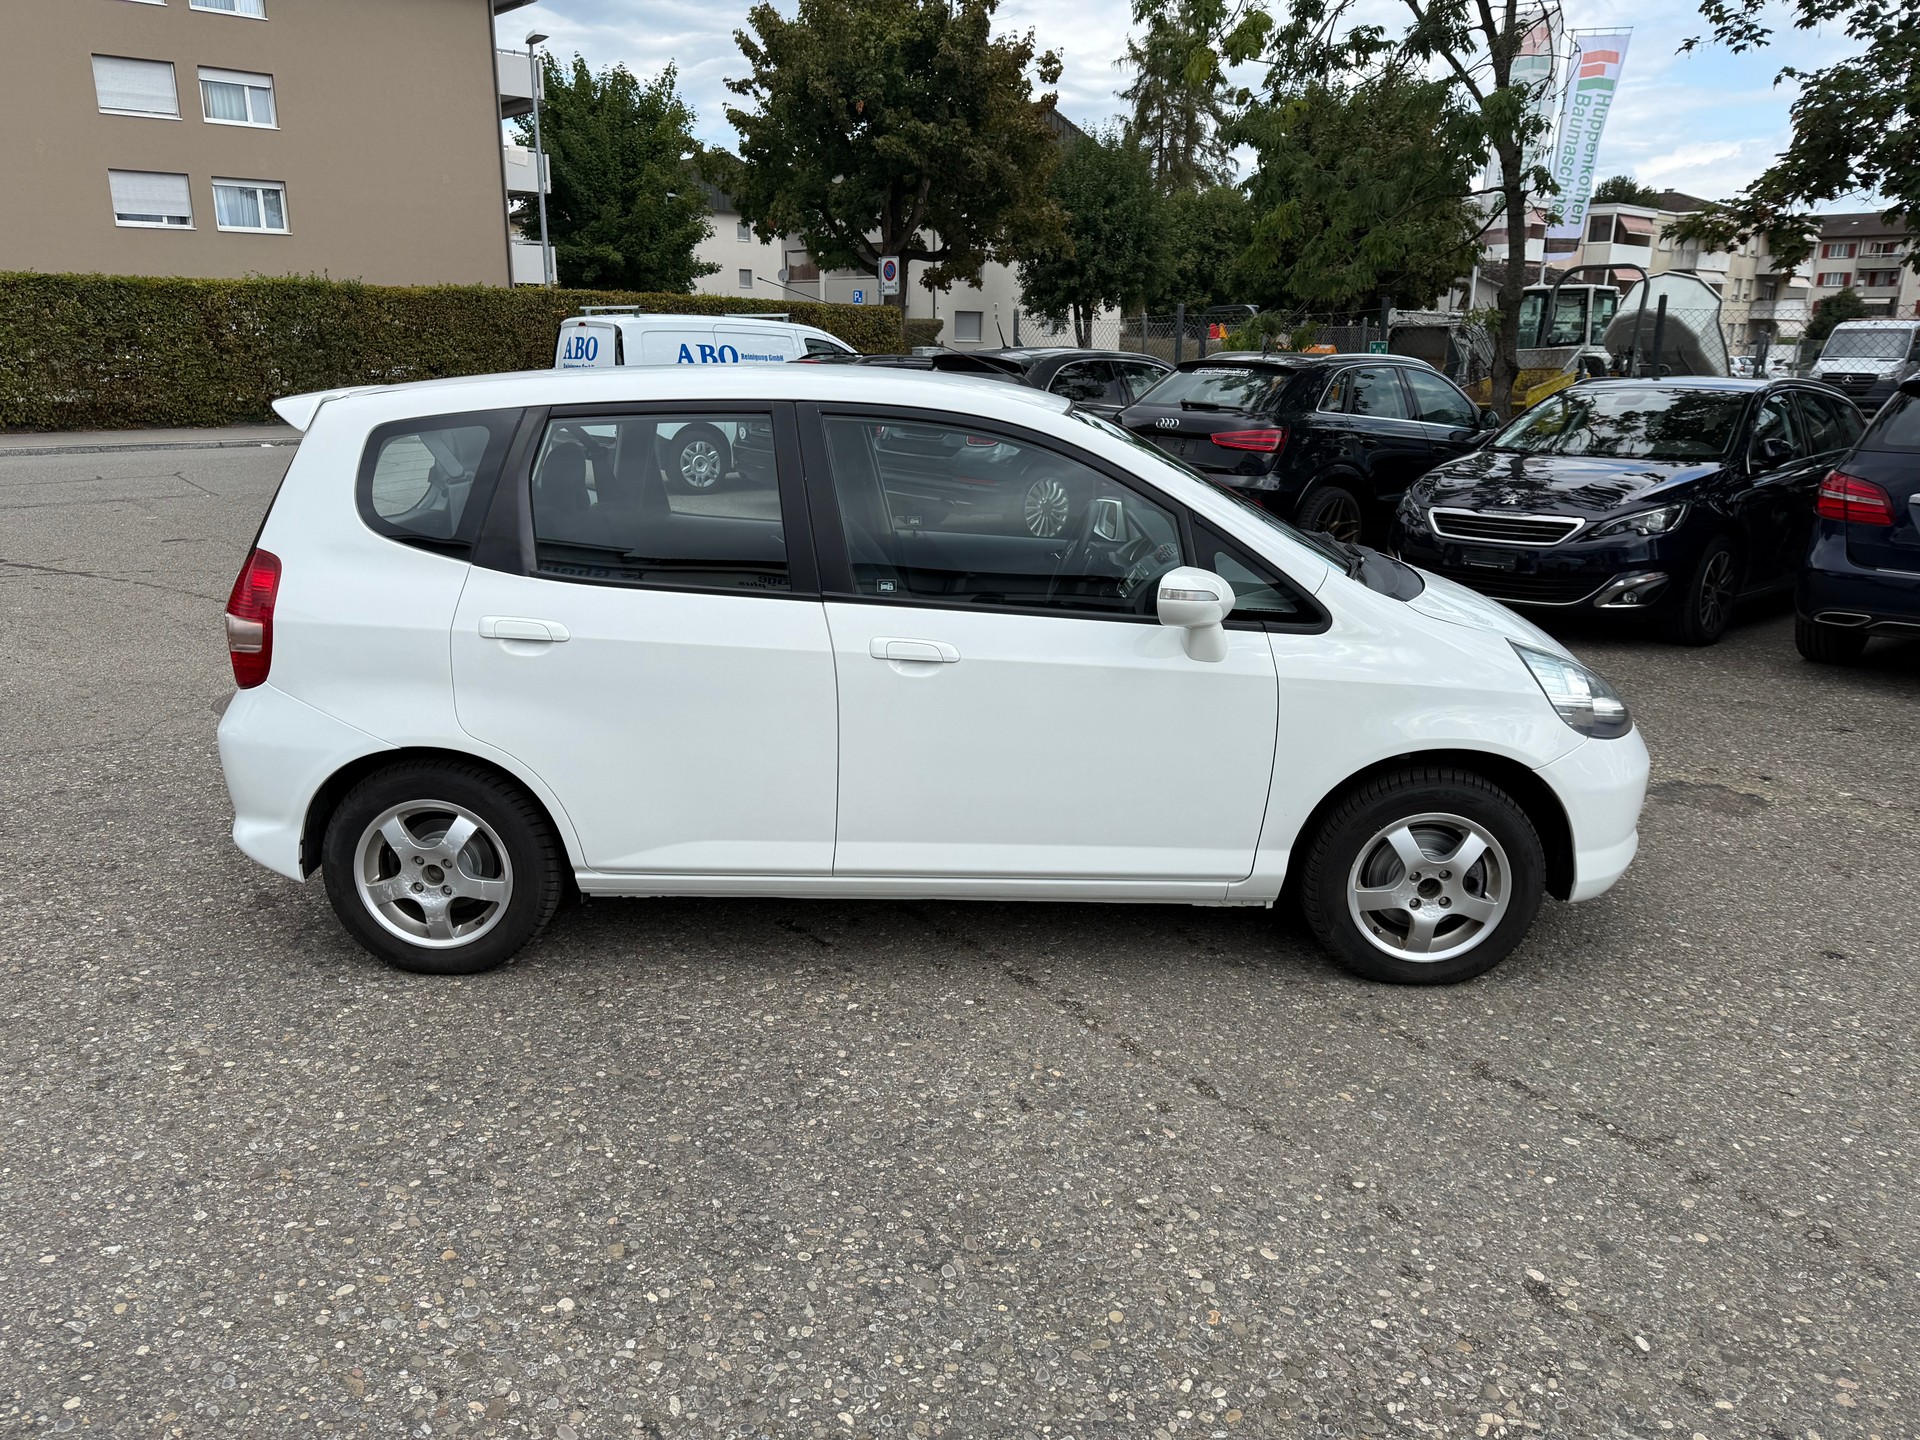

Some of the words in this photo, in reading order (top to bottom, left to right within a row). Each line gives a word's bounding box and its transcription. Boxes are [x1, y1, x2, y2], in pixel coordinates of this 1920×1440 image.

[1551, 93, 1592, 215] Baumaschine
[1569, 93, 1612, 225] Huppenkothen
[563, 336, 598, 361] ABO
[677, 343, 738, 364] ABO
[741, 353, 767, 362] Reinigung
[769, 354, 784, 362] GmbH
